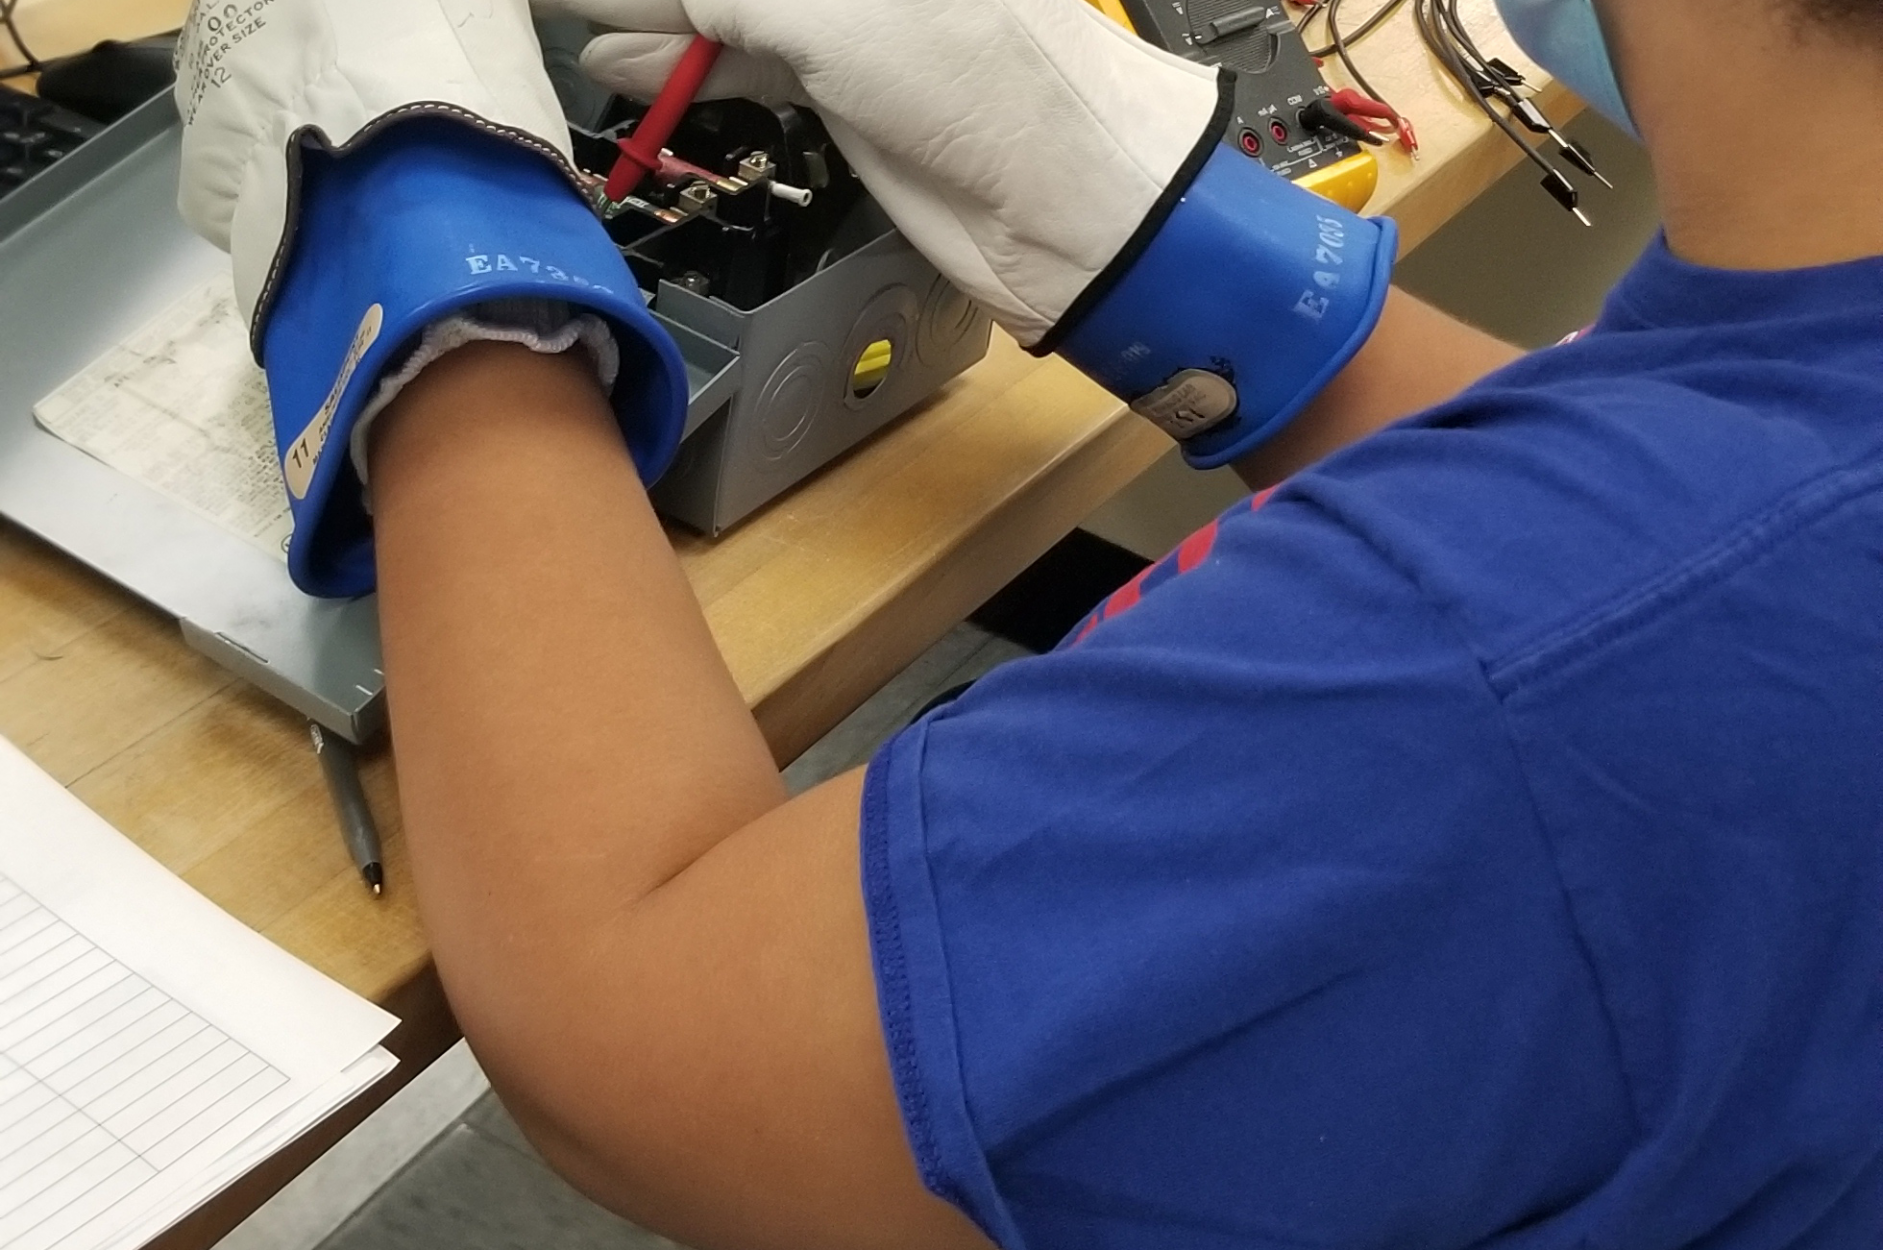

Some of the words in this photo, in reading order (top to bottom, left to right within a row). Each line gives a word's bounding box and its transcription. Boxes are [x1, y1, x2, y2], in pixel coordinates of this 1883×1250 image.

[231, 15, 267, 44] SIZE
[211, 66, 232, 89] 12
[291, 437, 310, 470] 11
